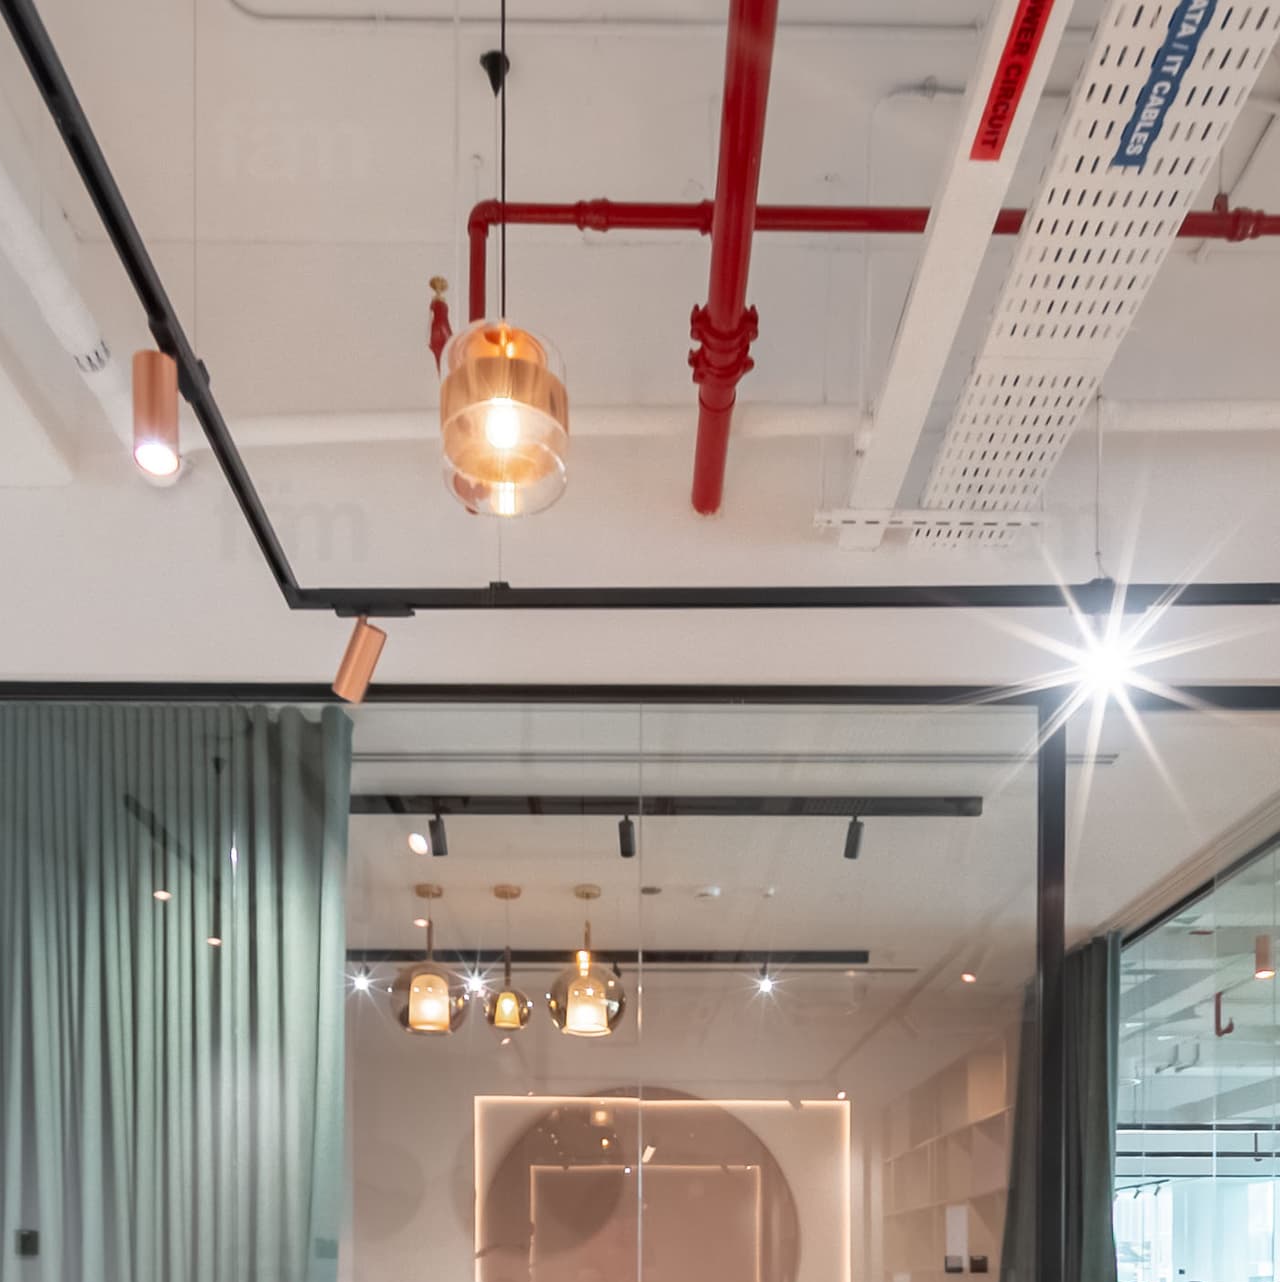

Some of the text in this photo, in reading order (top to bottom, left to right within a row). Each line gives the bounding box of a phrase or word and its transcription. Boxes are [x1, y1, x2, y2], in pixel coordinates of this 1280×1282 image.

[1161, 55, 1184, 76] IT
[981, 63, 1023, 149] CIRCUIT
[1125, 81, 1171, 156] CABLES
